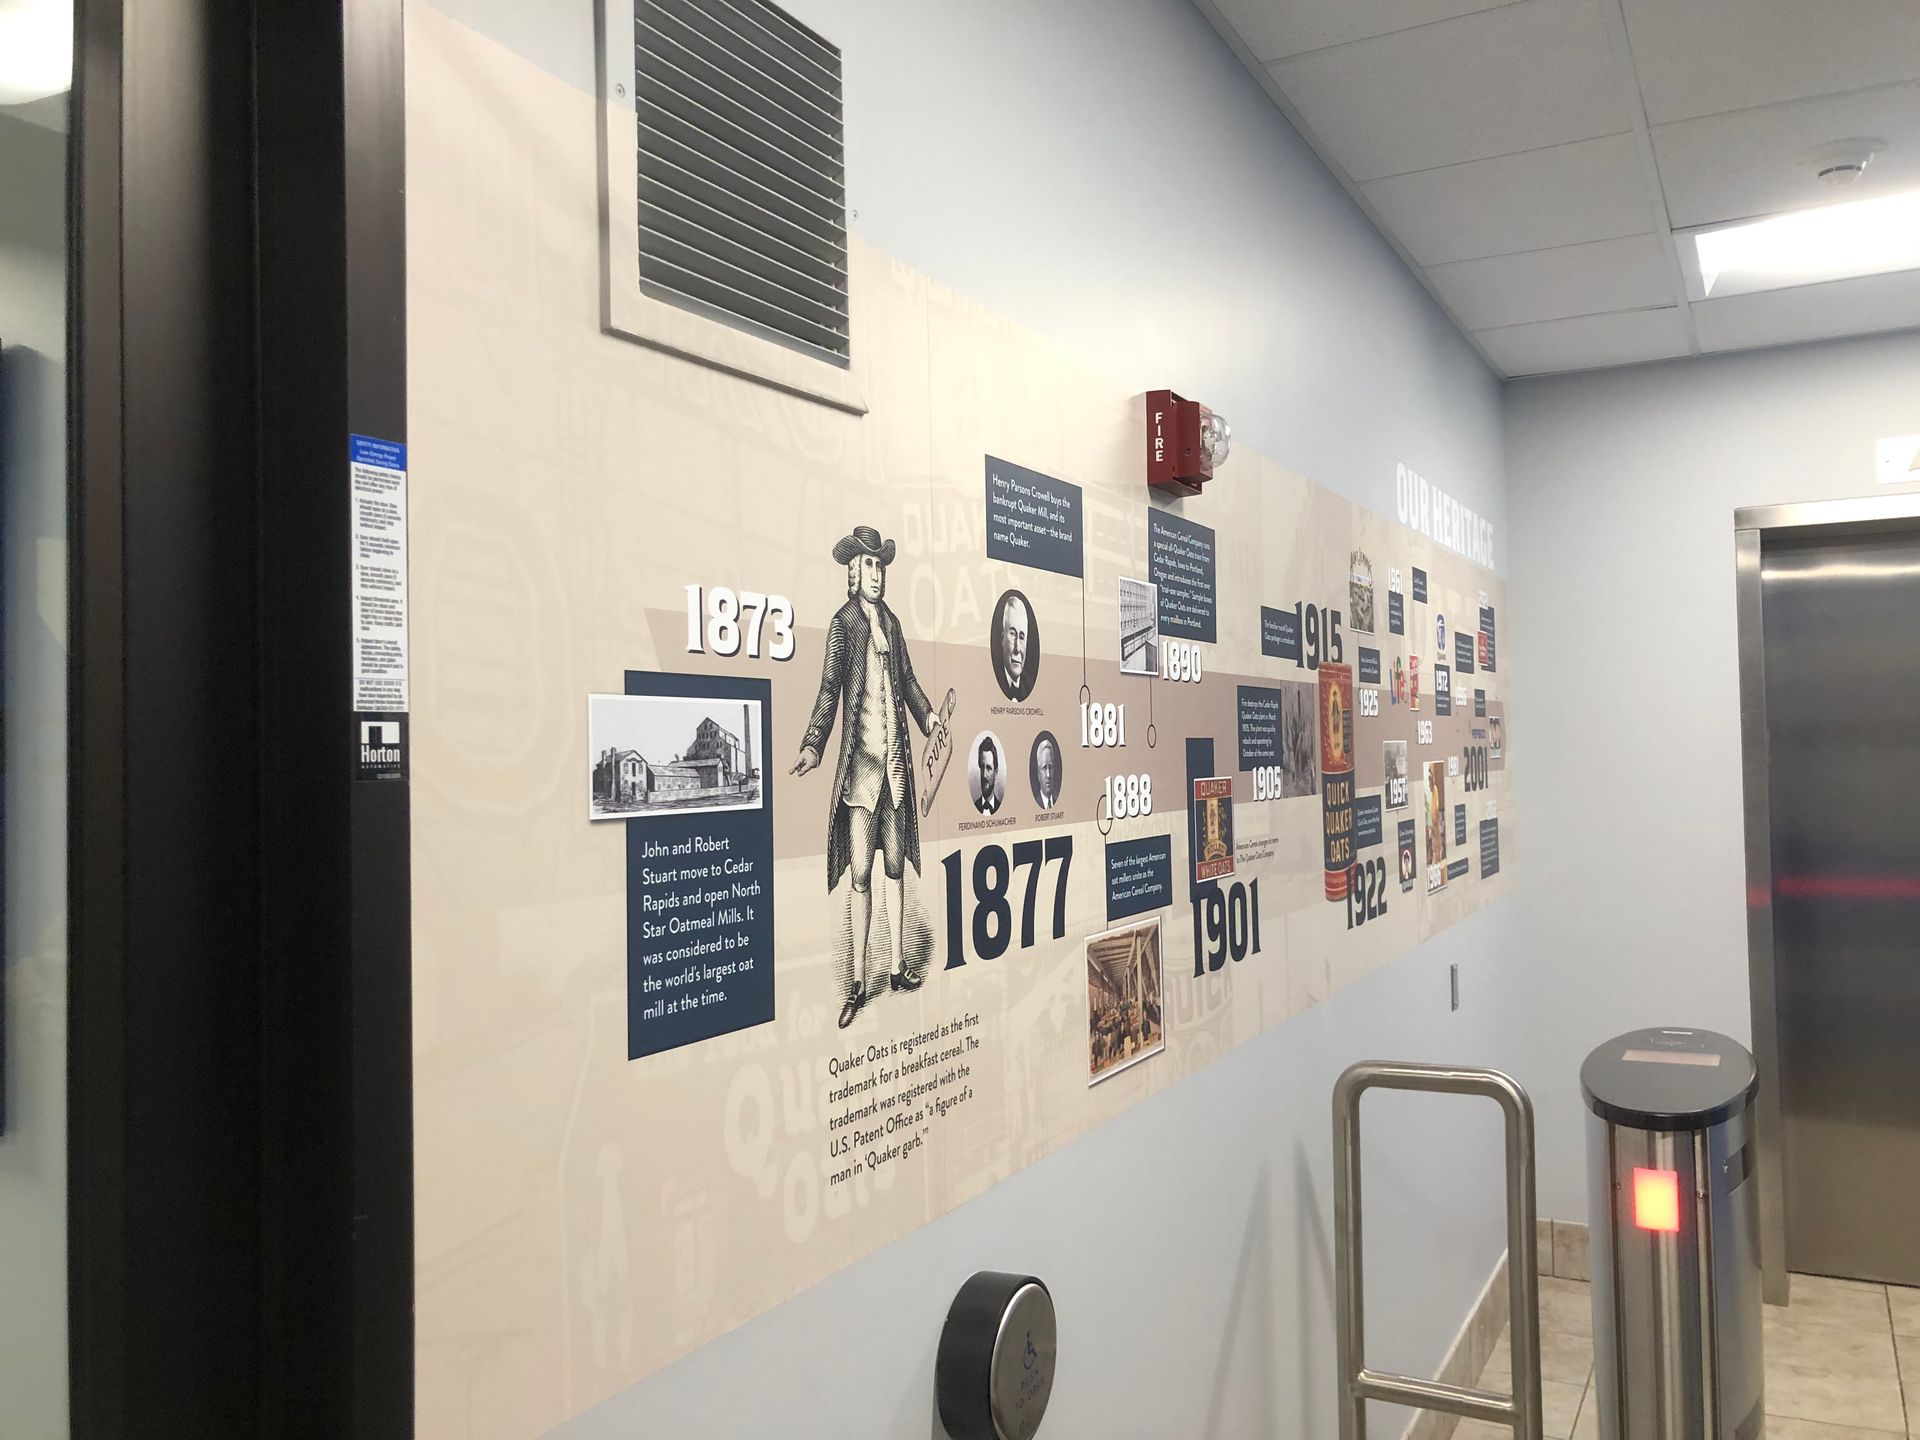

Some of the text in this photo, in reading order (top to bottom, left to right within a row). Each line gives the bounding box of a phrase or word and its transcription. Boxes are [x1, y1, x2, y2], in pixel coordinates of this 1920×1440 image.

[1155, 412, 1164, 462] FIRE
[992, 473, 1070, 508] Henry Parsons Crowell buys the
[992, 491, 1017, 512] bankrupt
[1018, 499, 1037, 514] Quaker
[1049, 511, 1058, 521] and
[993, 514, 1006, 524] most
[1007, 514, 1033, 531] important
[1059, 529, 1072, 542] brand
[1396, 462, 1494, 570] OUR HERITAGE
[993, 532, 1030, 547] name Quaker.
[684, 584, 796, 662] 1873
[1295, 601, 1342, 671] 1915
[1162, 641, 1202, 684] 1890
[991, 706, 1044, 716] HENRY PARSONS CROWELL
[1360, 689, 1378, 717] 1925
[1080, 702, 1126, 748] 1881
[361, 744, 400, 762] Horton
[926, 718, 950, 780] PURE
[1252, 766, 1282, 802] 1905
[1464, 746, 1488, 792] 2001
[1104, 773, 1152, 820] 1888
[1200, 780, 1226, 796] QUAKER
[1326, 780, 1350, 808] QUICK
[1390, 778, 1406, 804] 1957
[958, 816, 1016, 831] FERDINAND SCHUMACHER
[1035, 812, 1064, 822] ROBERT STUART
[1326, 808, 1352, 837] QUAKER
[641, 836, 729, 858] John and Robert
[1111, 858, 1123, 869] Seven
[1124, 856, 1128, 866] of
[1136, 855, 1148, 867] largest
[1148, 853, 1166, 861] American
[1331, 837, 1350, 863] OATS
[642, 857, 753, 884] Stuart move to Cedar
[1201, 860, 1231, 878] WHITE OATS
[643, 880, 760, 916] Rapids and open North
[941, 835, 1073, 971] 1877
[1112, 889, 1131, 900] American
[1131, 885, 1144, 896] Cereal
[1346, 856, 1387, 930] 1922
[643, 905, 754, 938] Star Oatmeal Mills. It
[1190, 877, 1261, 978] 1901
[643, 932, 749, 965] was considered to be
[643, 957, 753, 992] the world's largest oat
[644, 989, 727, 1019] mill at the time.
[829, 1013, 979, 1078] Quaker Oats is registered as the first
[829, 1036, 979, 1103] trademark for a breakfast cereal. The
[829, 1063, 969, 1131] trademark was registered with the
[830, 1136, 850, 1157] U.S.
[854, 1124, 883, 1148] Patent
[886, 1112, 913, 1133] Office
[915, 1110, 923, 1122] as
[935, 1096, 957, 1116] figure
[959, 1085, 967, 1102] of
[968, 1089, 972, 1098] a
[830, 1168, 851, 1186] man
[853, 1159, 862, 1175] in
